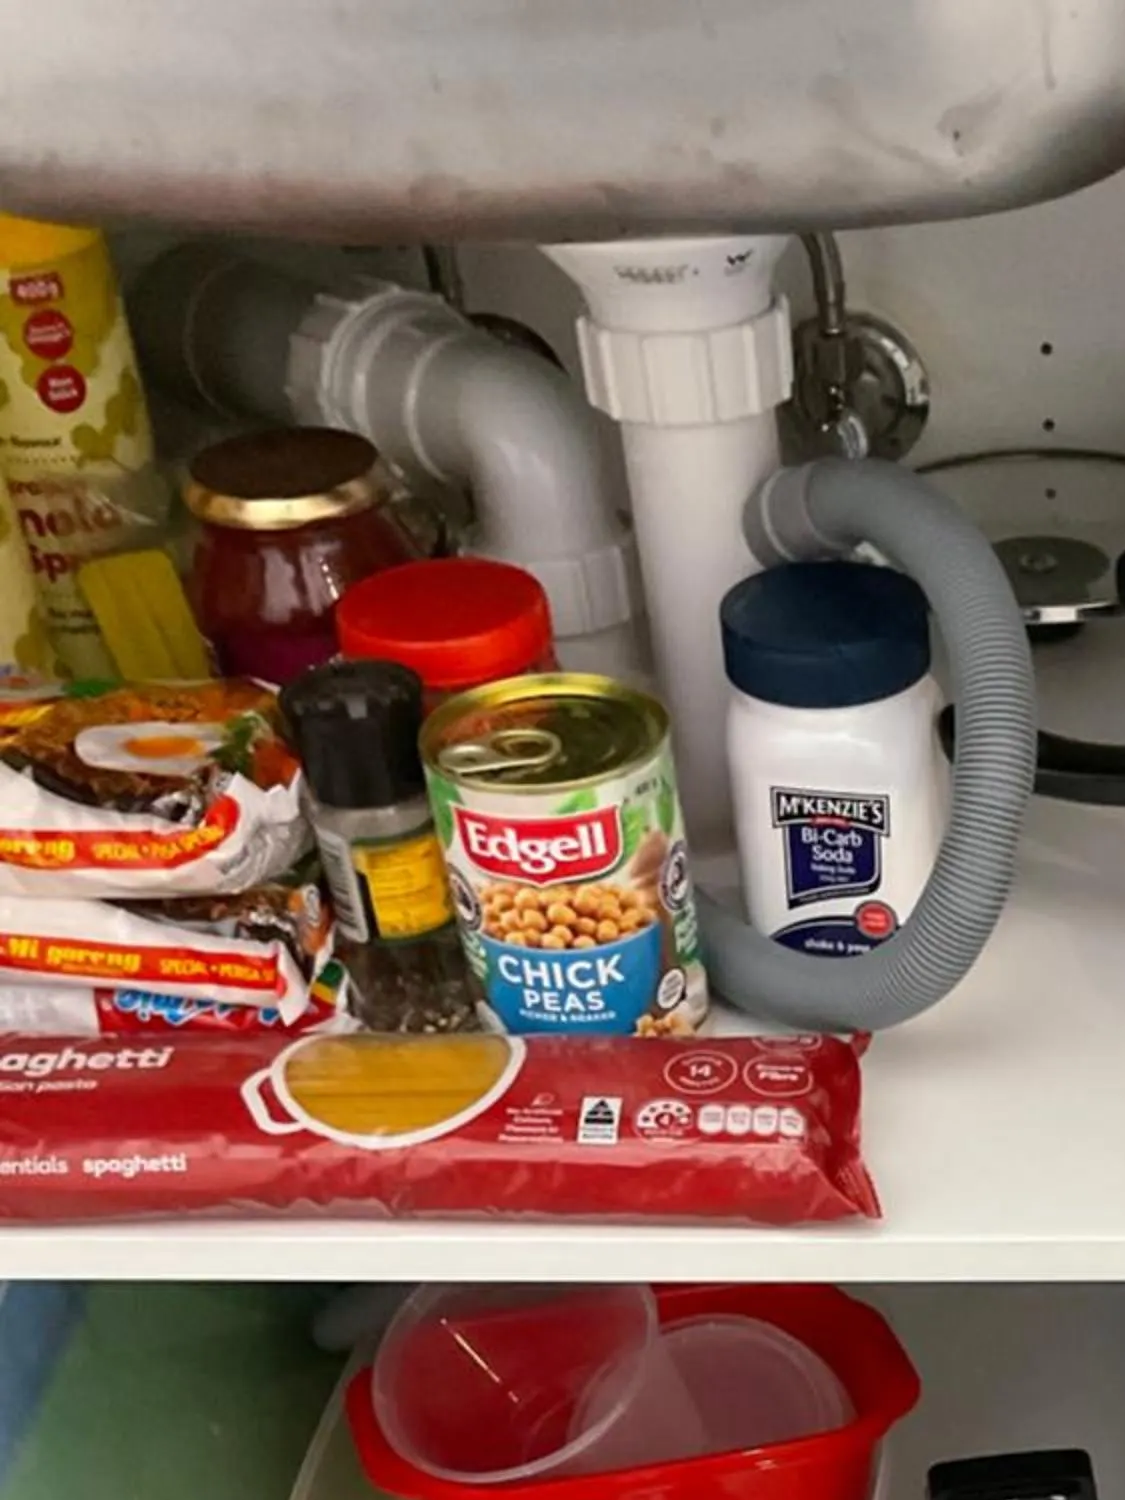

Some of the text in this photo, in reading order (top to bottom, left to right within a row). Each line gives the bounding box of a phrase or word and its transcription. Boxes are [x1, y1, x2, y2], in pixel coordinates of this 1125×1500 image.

[0, 837, 75, 863] oreng
[464, 819, 607, 874] Edgell
[801, 827, 863, 848] Bi-Carb
[812, 844, 853, 863] Soda
[46, 945, 141, 974] goreng
[498, 953, 624, 989] CHICK
[523, 988, 605, 1013] PEAS
[0, 1046, 175, 1078] aghetti
[0, 1152, 187, 1178] entials spaghetti
